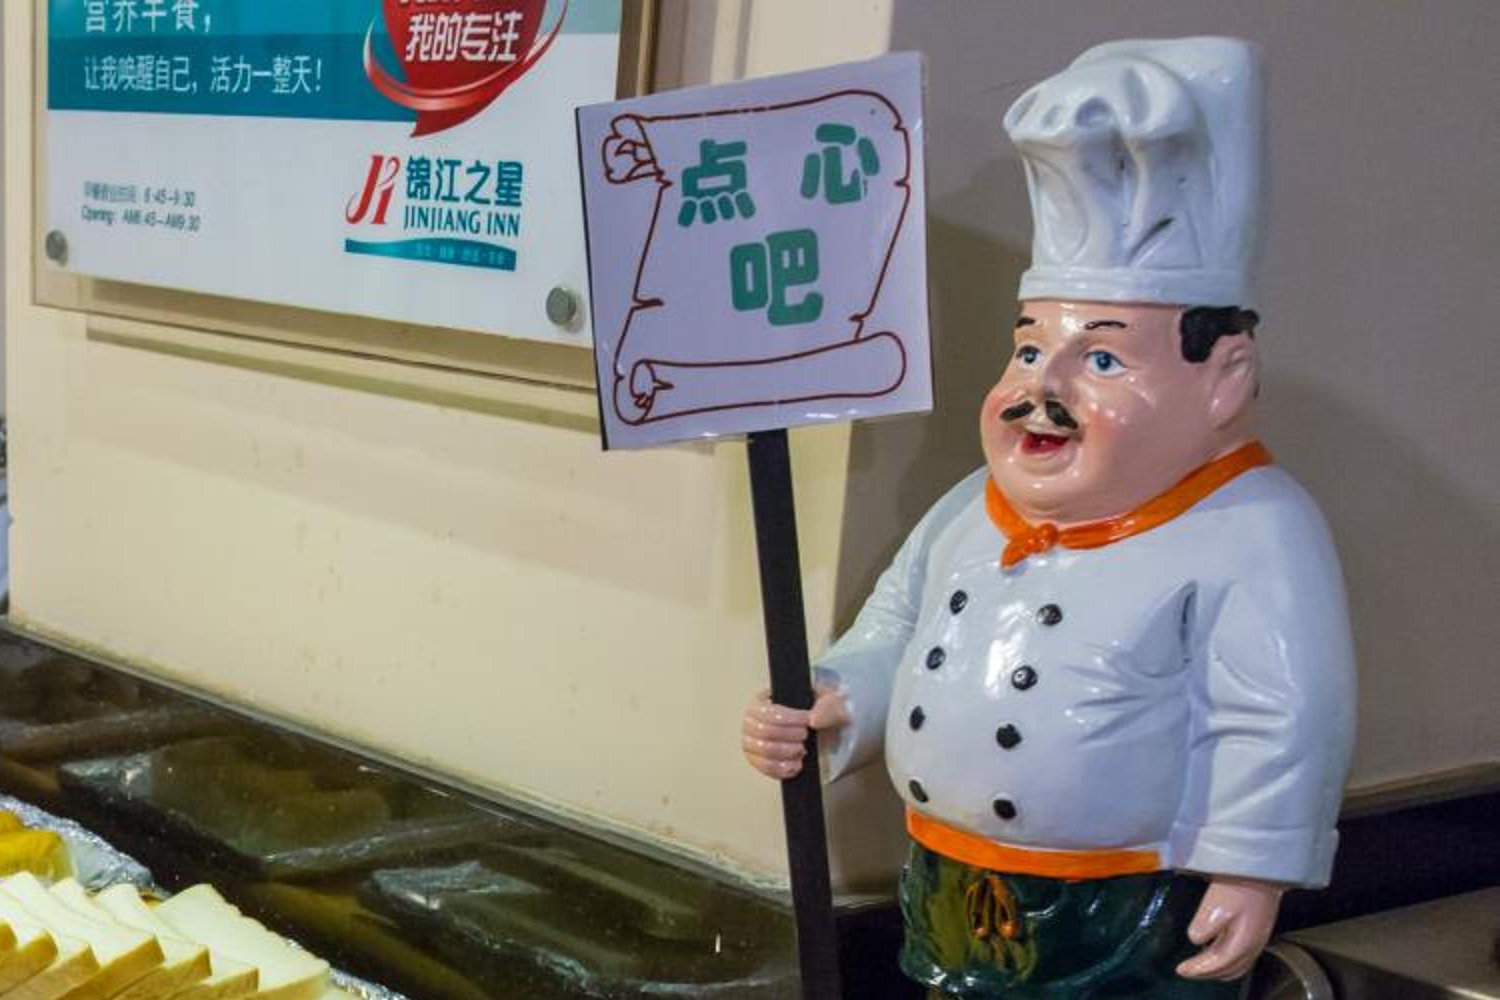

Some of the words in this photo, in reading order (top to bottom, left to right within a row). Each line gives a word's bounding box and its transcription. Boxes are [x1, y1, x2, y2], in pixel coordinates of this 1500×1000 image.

[405, 10, 523, 62] 我的专注
[406, 155, 524, 207] 锦江之星
[404, 205, 481, 235] JINJIANG
[487, 212, 521, 237] INN
[729, 229, 824, 327] 吧
